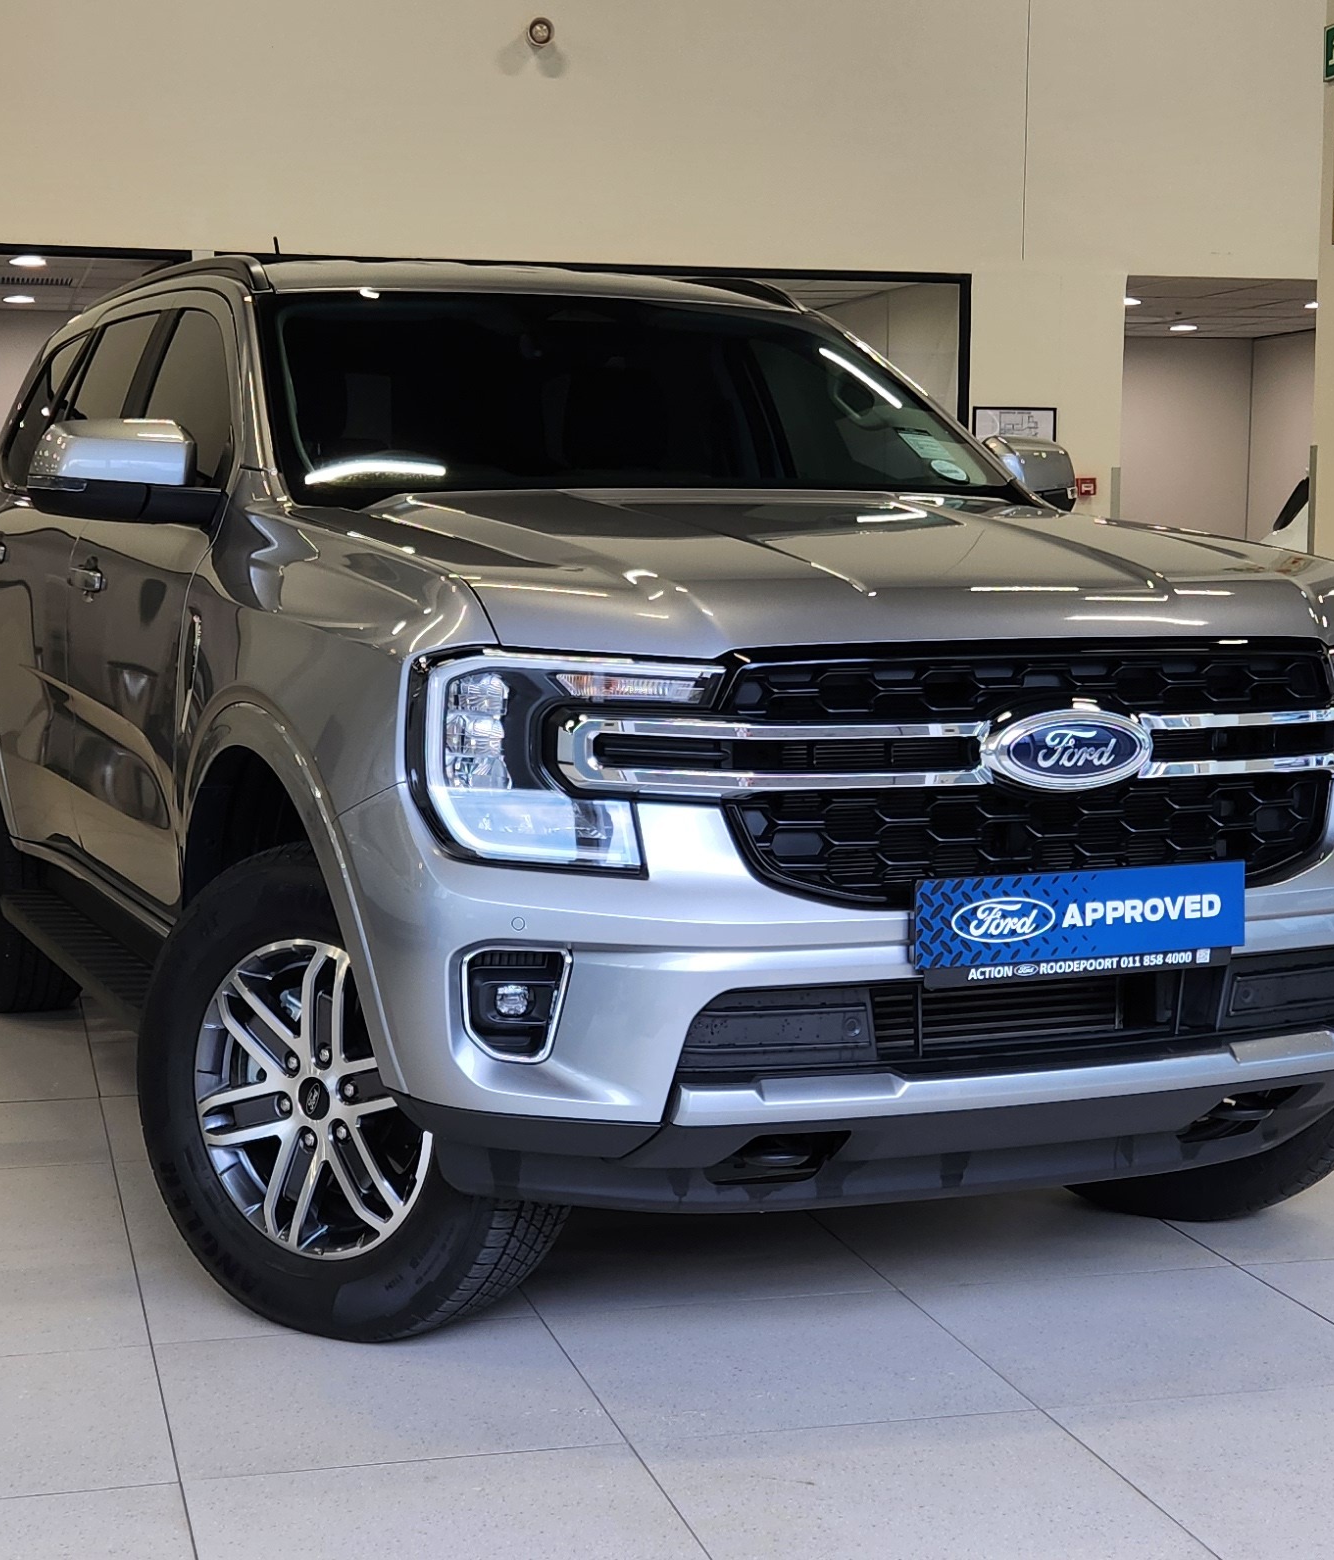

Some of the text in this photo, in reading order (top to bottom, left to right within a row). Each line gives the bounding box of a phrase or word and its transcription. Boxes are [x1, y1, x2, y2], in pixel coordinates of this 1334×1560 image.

[1037, 729, 1117, 768] Ford
[969, 893, 1222, 937] Ford APPROVED
[967, 965, 1013, 981] ACTION
[1039, 957, 1118, 975] ROODEPOORT
[1120, 955, 1142, 968] 011
[1142, 953, 1164, 967] 858
[1165, 951, 1193, 965] 4000
